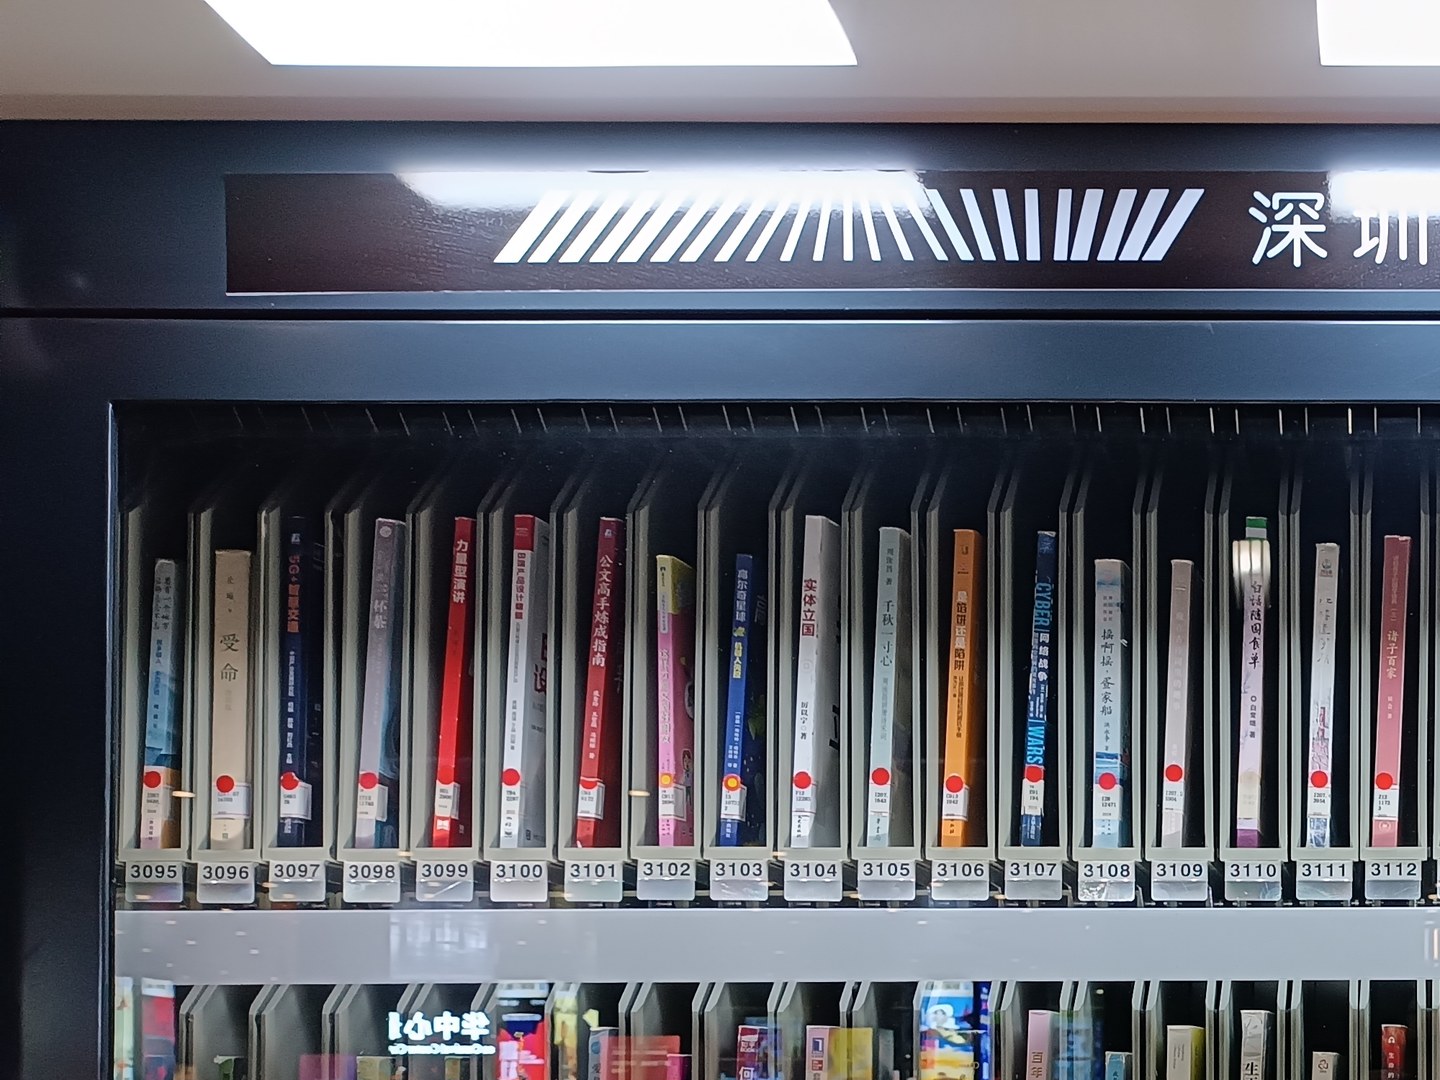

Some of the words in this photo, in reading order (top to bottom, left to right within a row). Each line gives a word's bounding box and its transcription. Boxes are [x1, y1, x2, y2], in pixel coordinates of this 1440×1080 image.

[453, 540, 470, 604] 力量型演讲
[801, 578, 818, 637] 实体立国
[1034, 579, 1055, 628] CYBER
[881, 600, 896, 668] 千秋一寸心
[220, 633, 240, 683] 受命
[1025, 725, 1046, 765] WARS
[130, 864, 177, 879] 3095
[202, 865, 249, 880] 3096
[274, 863, 320, 878] 3097
[349, 864, 395, 879] 3098
[421, 863, 468, 878] 3099
[496, 864, 543, 878] 3100
[570, 863, 615, 878] 3101
[643, 862, 691, 877] 3102
[715, 862, 763, 877] 3103
[790, 863, 837, 877] 3104
[863, 862, 910, 877] 3105
[937, 862, 984, 877] 3106
[1010, 862, 1057, 877] 3107
[1083, 863, 1131, 878] 3108
[1156, 863, 1203, 877] 3109
[1230, 863, 1277, 878] 3110
[1301, 863, 1345, 877] 3111
[1371, 862, 1417, 877] 3112
